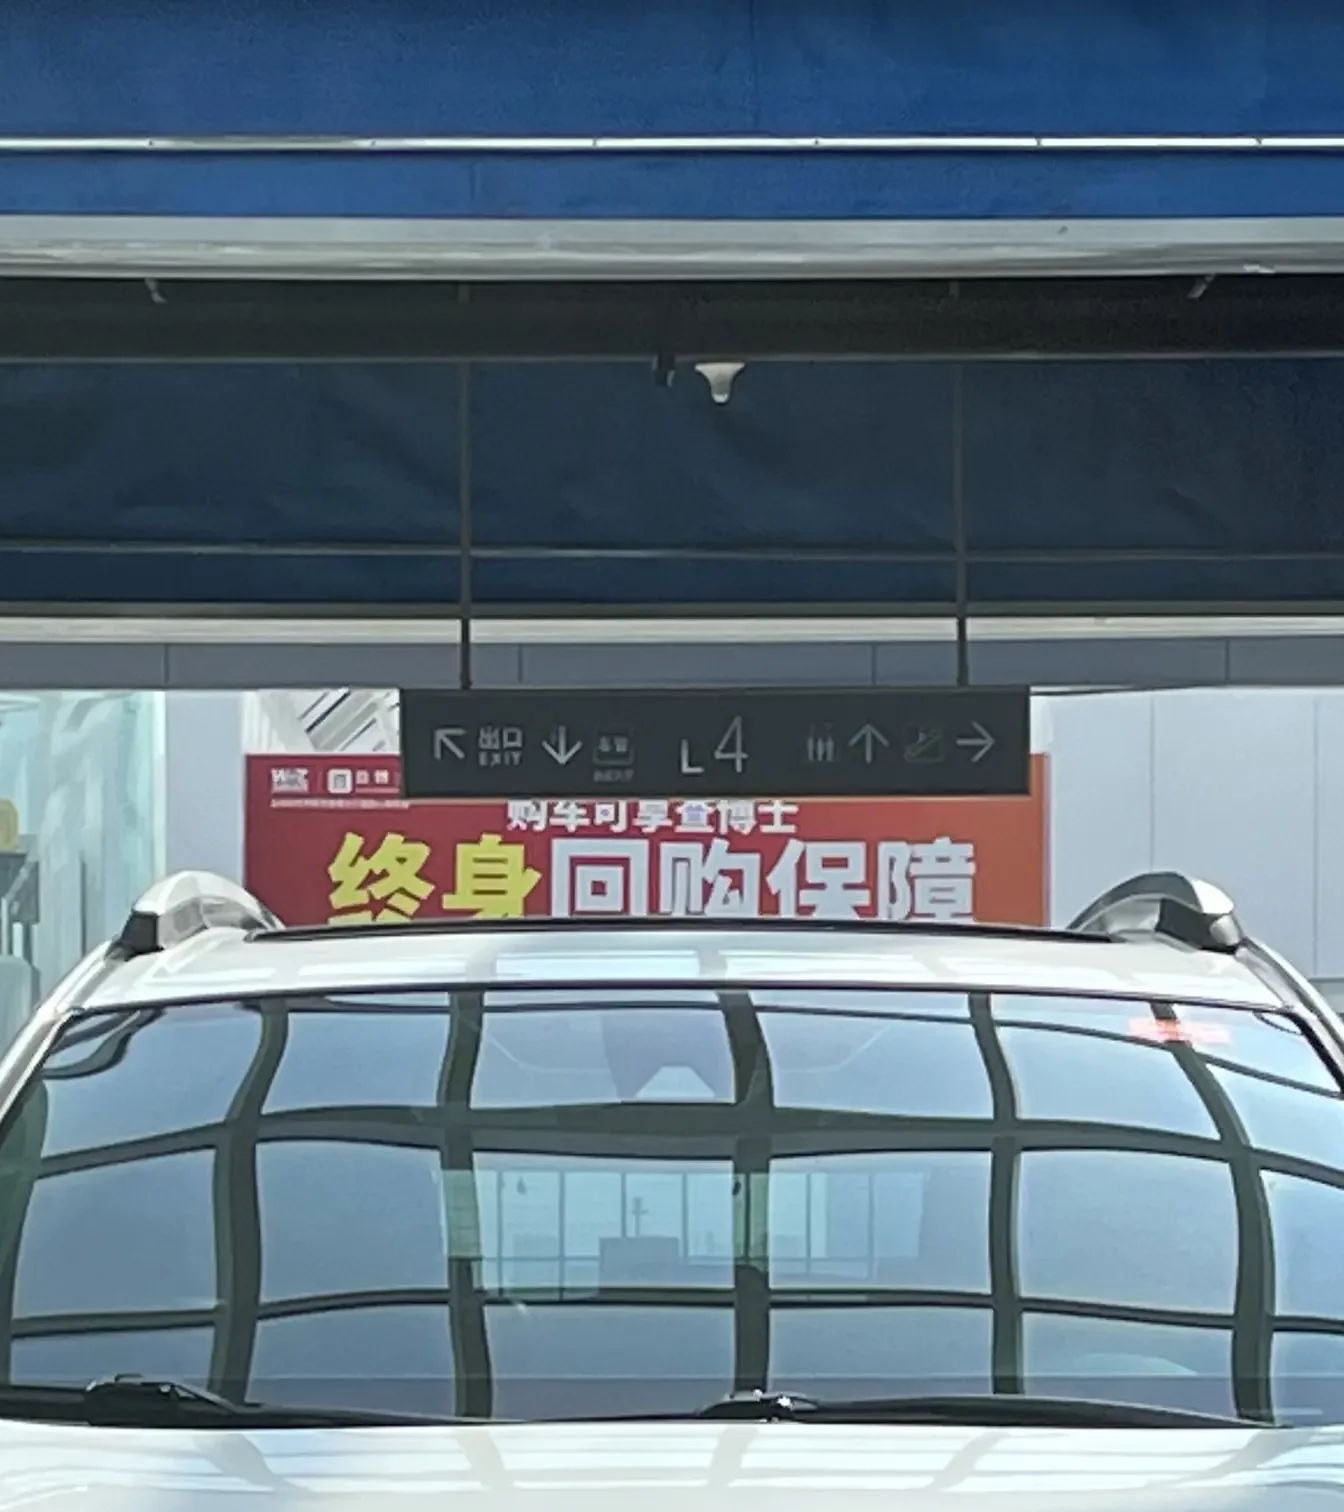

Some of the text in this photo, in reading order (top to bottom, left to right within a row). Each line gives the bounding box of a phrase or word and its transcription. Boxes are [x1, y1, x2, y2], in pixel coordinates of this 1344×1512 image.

[478, 725, 524, 750] 出口
[680, 716, 749, 774] L4
[478, 751, 523, 767] EXIT
[327, 832, 978, 924] 终身回购保障
